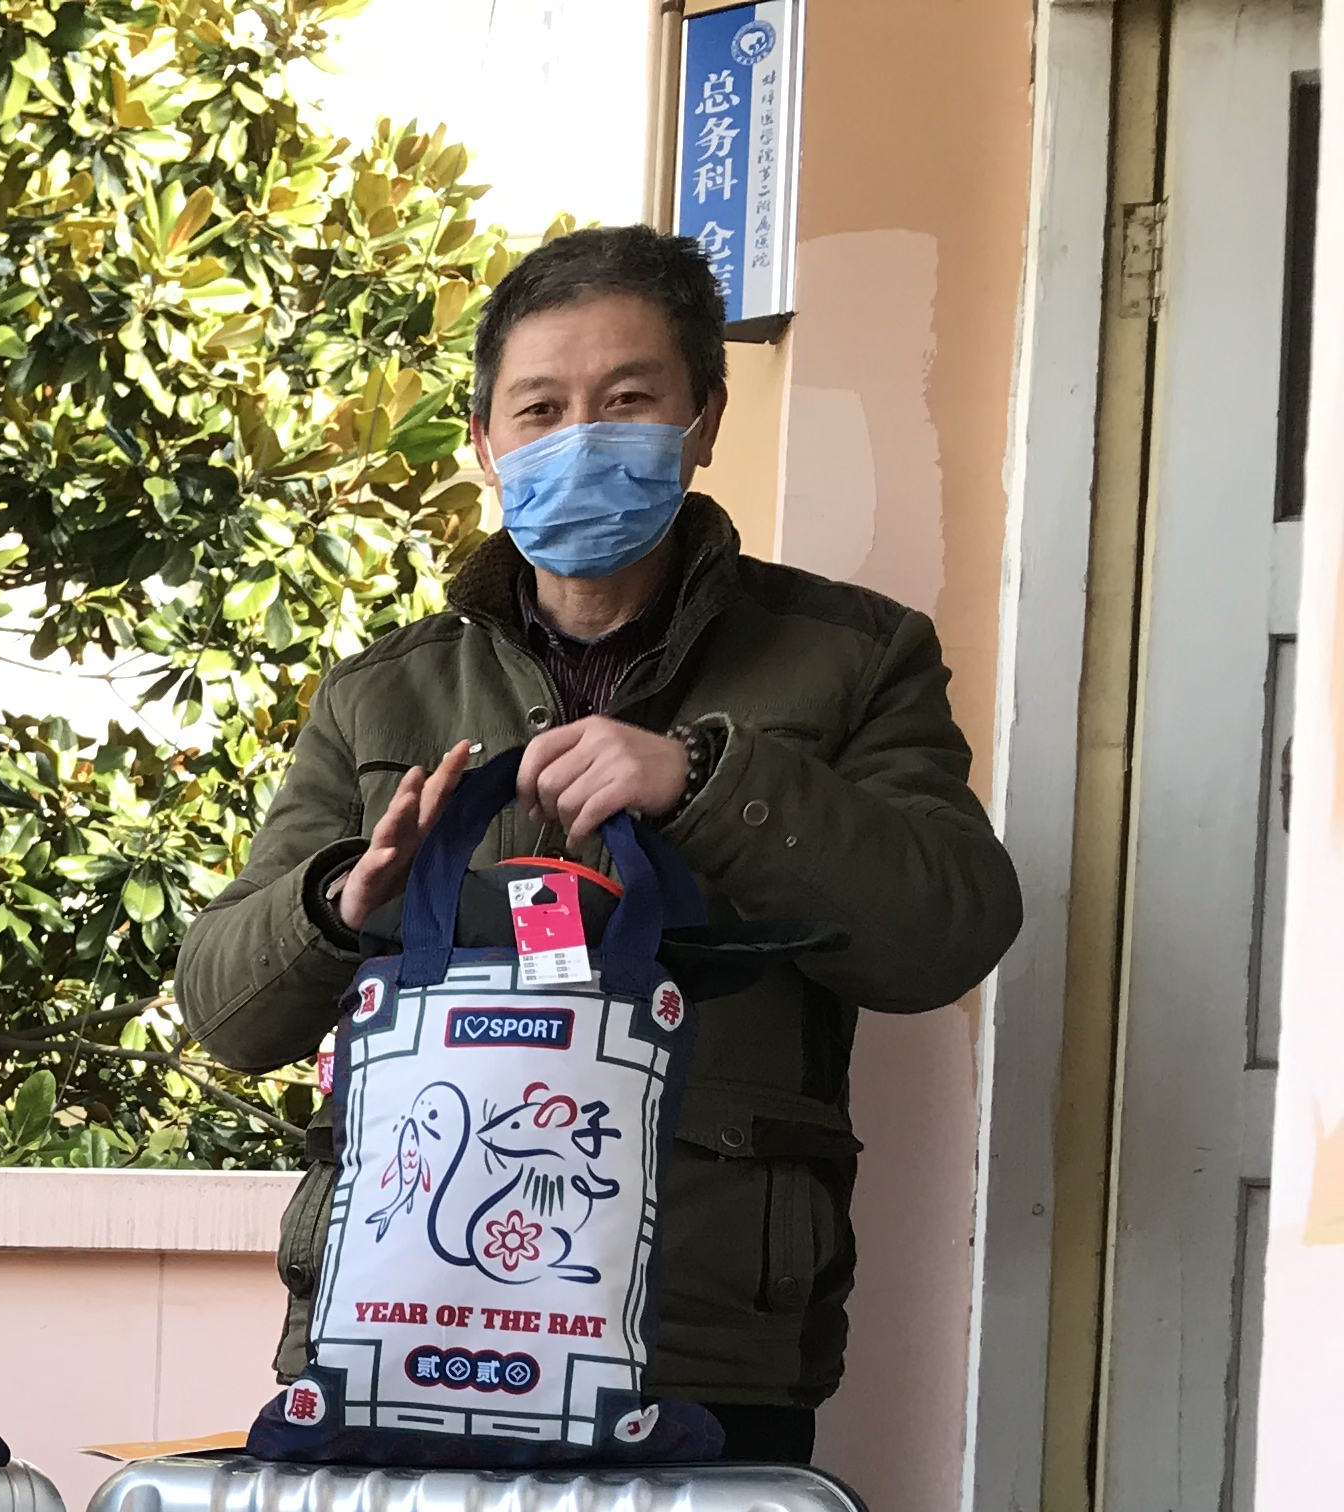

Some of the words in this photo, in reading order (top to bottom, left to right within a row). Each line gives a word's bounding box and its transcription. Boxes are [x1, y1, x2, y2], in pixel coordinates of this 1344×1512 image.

[693, 70, 740, 204] 总务科
[658, 987, 682, 1026] 寿
[488, 1018, 564, 1040] SPORT
[355, 1302, 428, 1324] YEAR
[435, 1305, 474, 1327] OF
[481, 1308, 541, 1332] THE
[548, 1313, 607, 1338] RAT
[287, 1386, 319, 1421] 康
